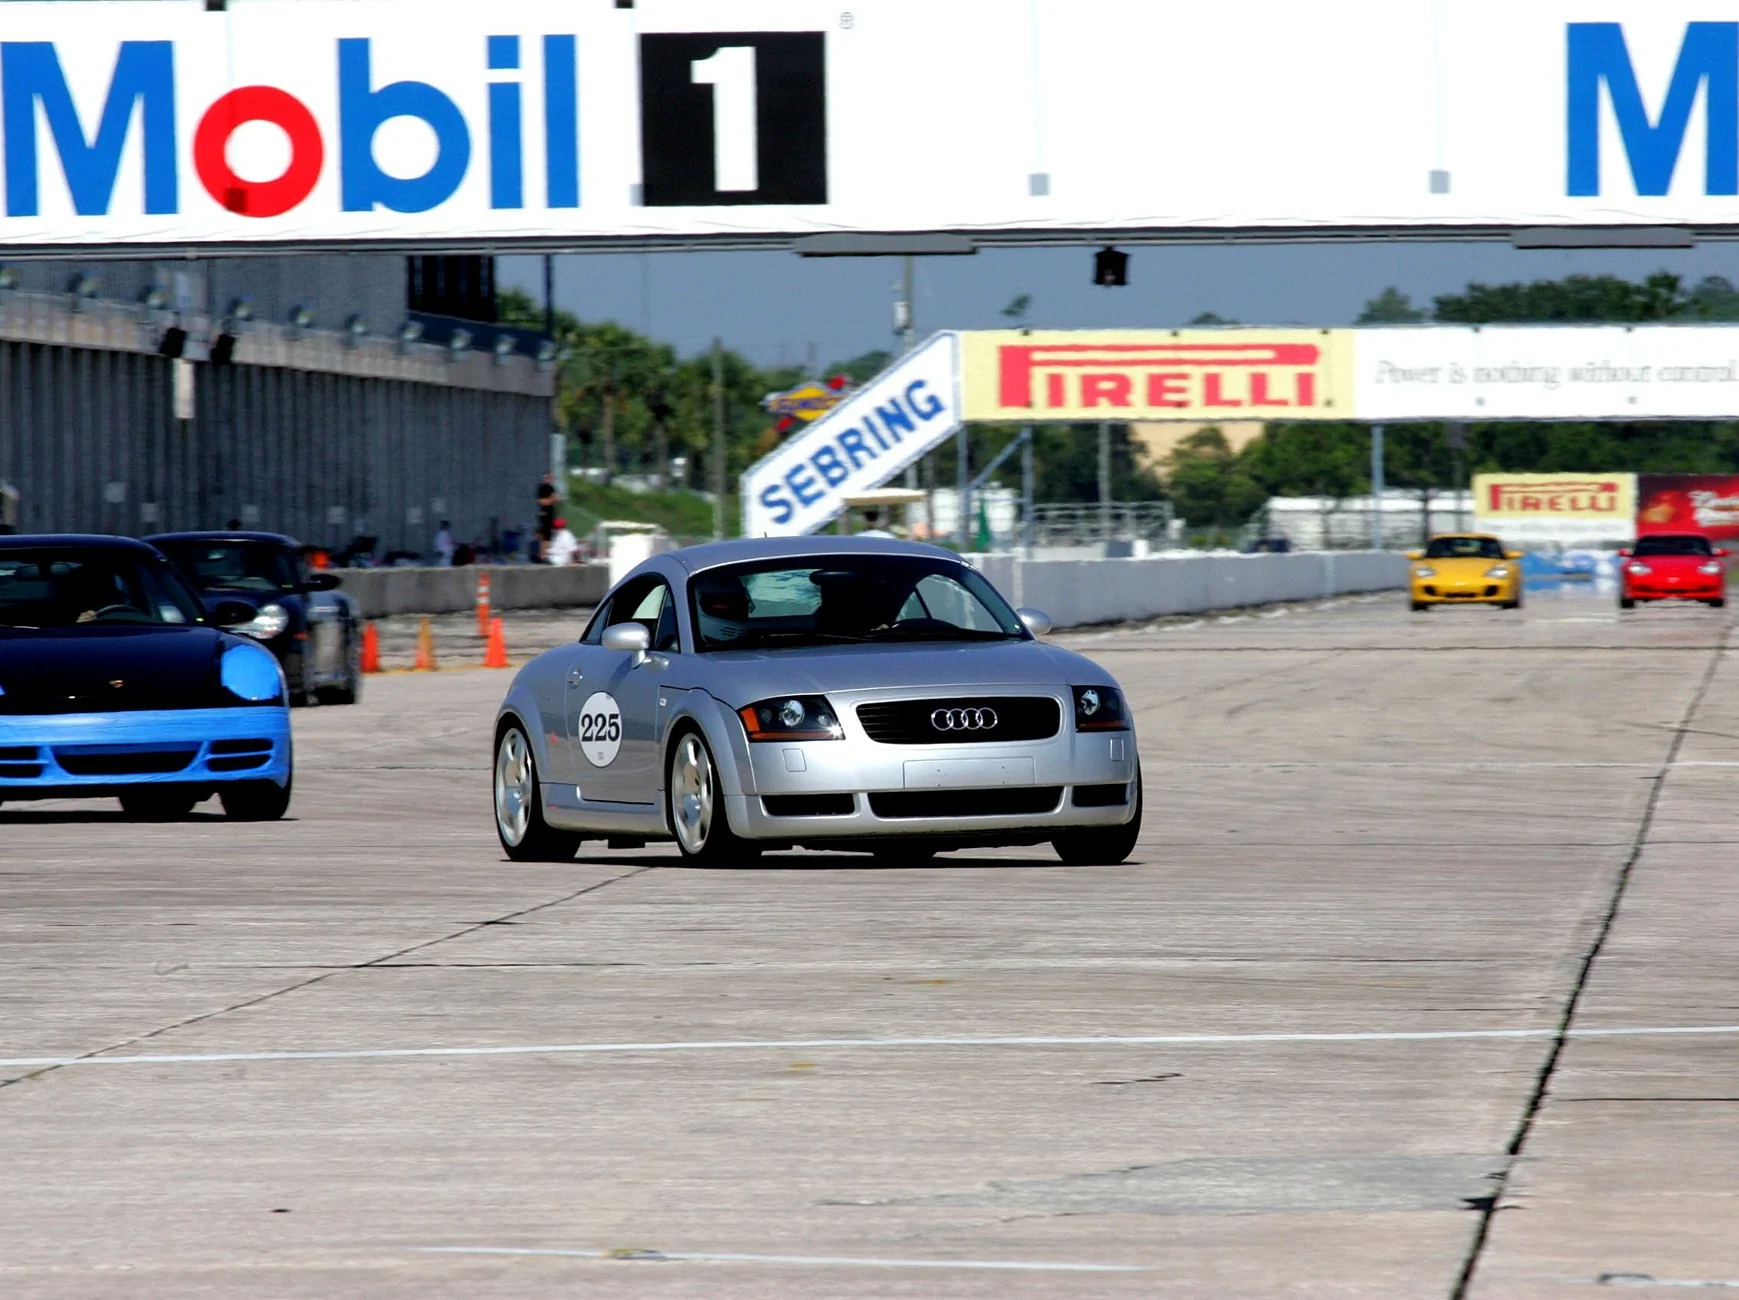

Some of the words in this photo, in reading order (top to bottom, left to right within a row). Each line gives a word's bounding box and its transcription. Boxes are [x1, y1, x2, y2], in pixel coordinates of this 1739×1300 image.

[1, 34, 580, 218] Mobil
[690, 46, 758, 192] 1
[998, 343, 1320, 408] PIRELLI
[1374, 360, 1442, 384] Power
[1448, 361, 1468, 384] is
[1473, 360, 1563, 390] nothing
[759, 379, 945, 524] SEBRING
[1488, 482, 1619, 512] PIRELLI
[581, 713, 620, 742] 225
